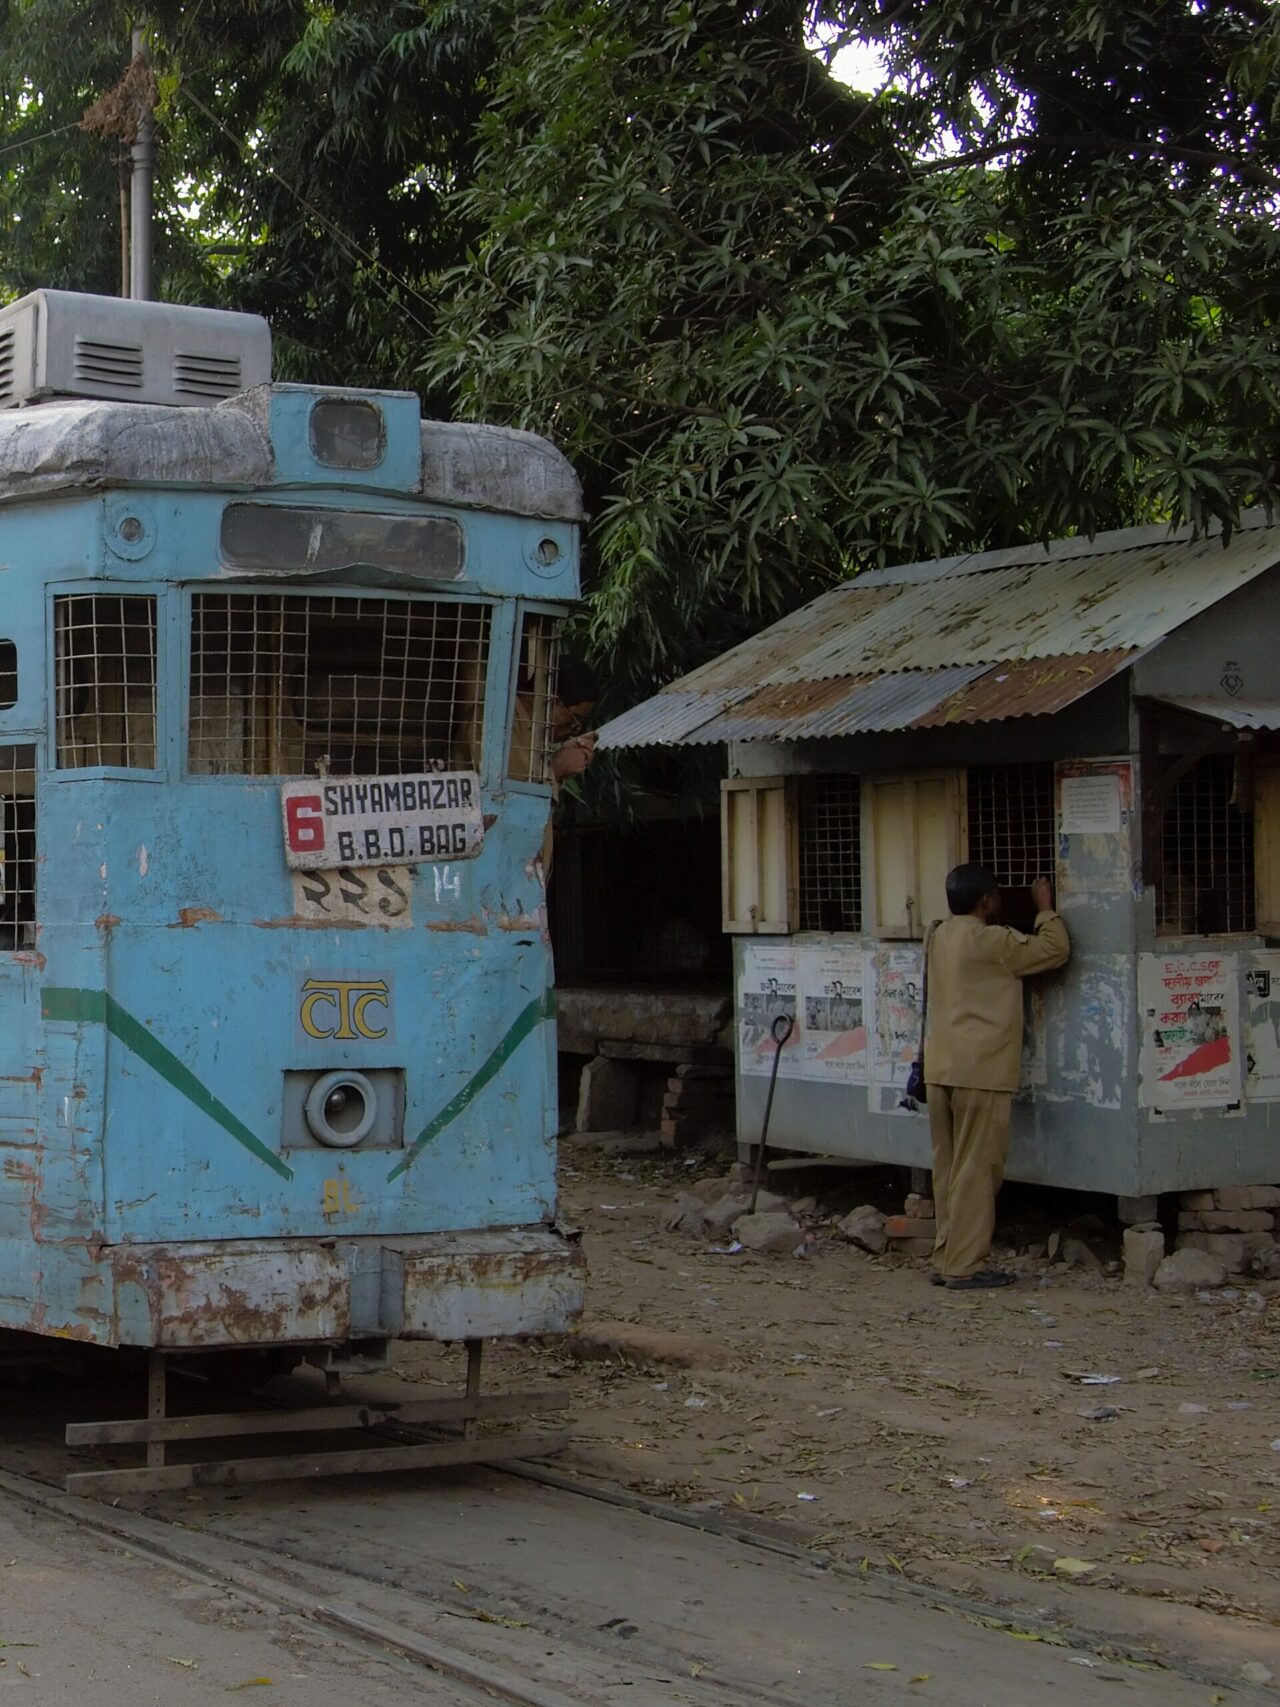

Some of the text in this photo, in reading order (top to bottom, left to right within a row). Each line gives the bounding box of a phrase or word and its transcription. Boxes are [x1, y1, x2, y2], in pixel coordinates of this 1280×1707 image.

[324, 778, 473, 816] SHYAMBAZAR
[286, 795, 325, 853] 6
[420, 823, 466, 856] BAG
[300, 978, 389, 1040] CTC
